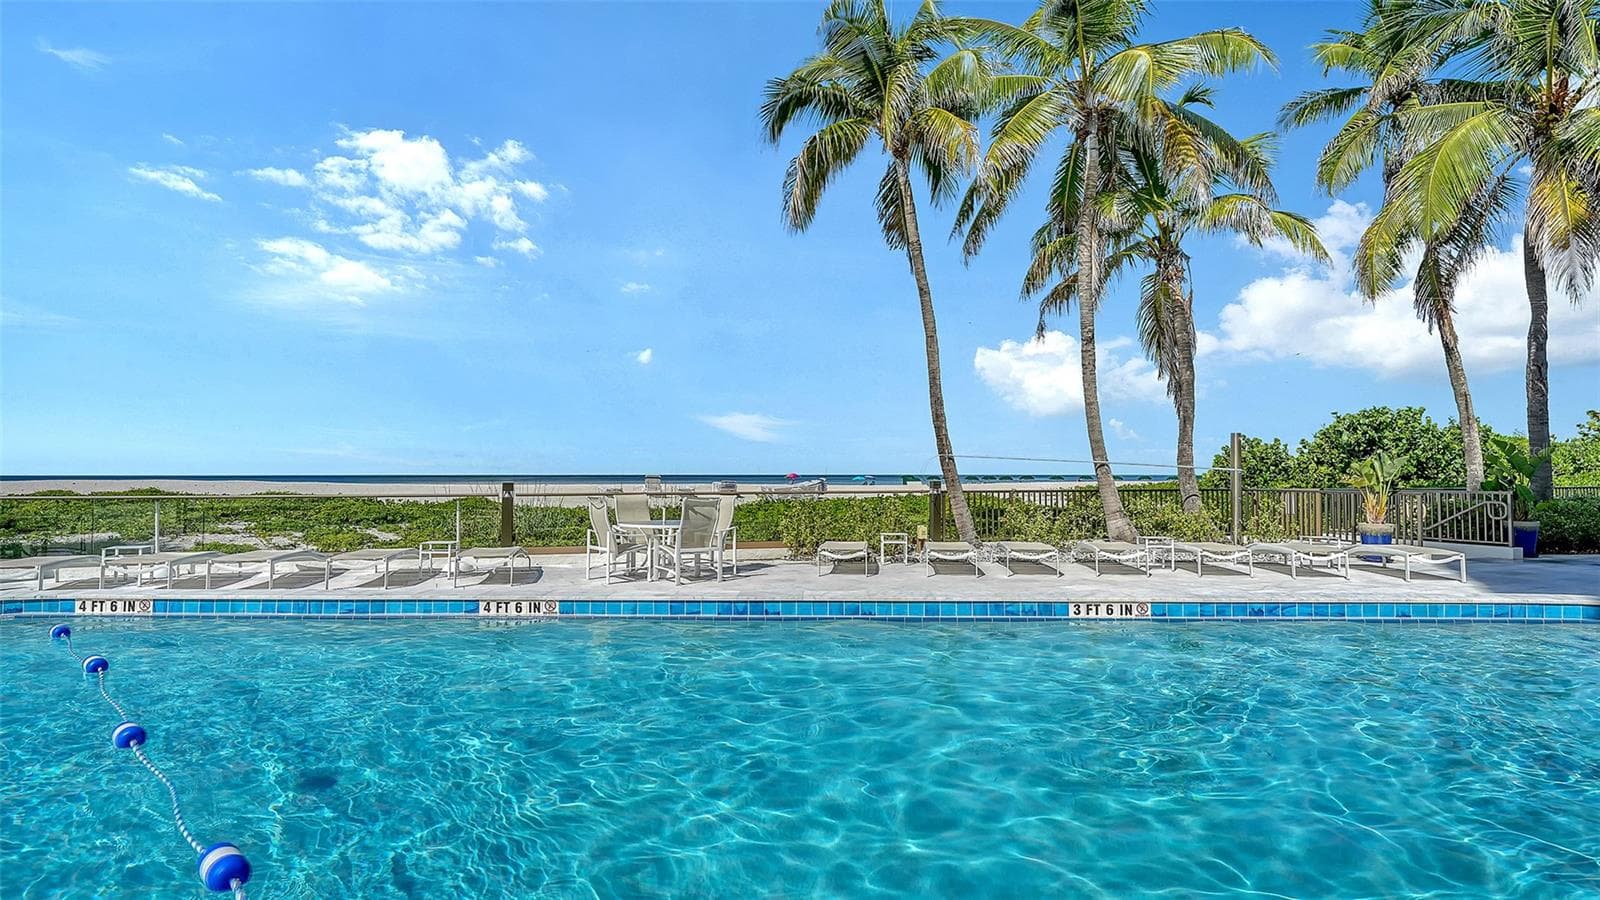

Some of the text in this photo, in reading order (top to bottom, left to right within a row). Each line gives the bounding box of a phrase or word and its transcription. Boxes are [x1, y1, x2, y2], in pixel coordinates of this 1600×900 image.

[78, 600, 135, 612] 4 FT 6 IN
[483, 602, 541, 613] 4 FT 6 IN
[1073, 604, 1132, 616] 3 FT 6 IN
